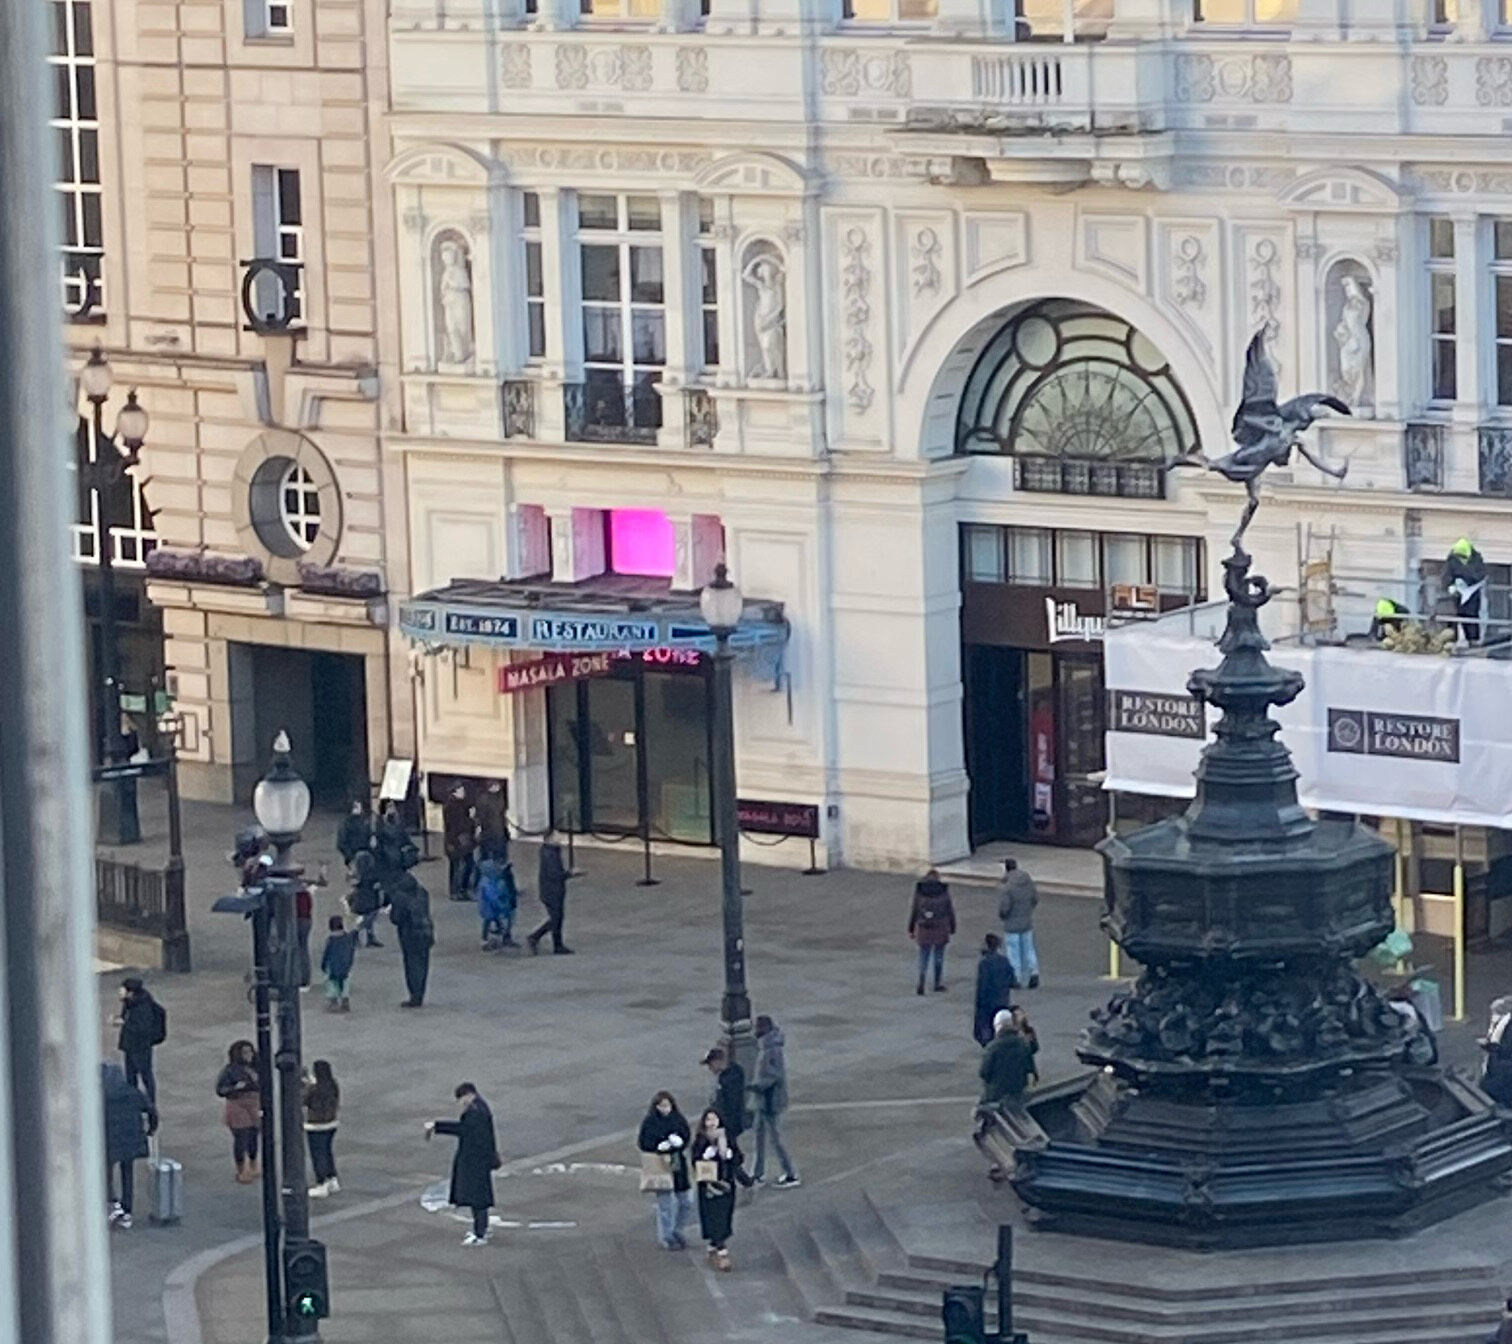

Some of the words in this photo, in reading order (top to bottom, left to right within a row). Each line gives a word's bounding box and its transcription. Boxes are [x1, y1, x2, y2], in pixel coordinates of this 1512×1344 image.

[535, 619, 654, 641] RESTAURANT
[507, 660, 566, 687] MASALA
[571, 653, 609, 677] ZONE
[1120, 694, 1201, 717] RESTORE
[1120, 711, 1201, 733] LONDON
[1373, 717, 1452, 740] RESTORE
[1373, 733, 1453, 755] LONDON
